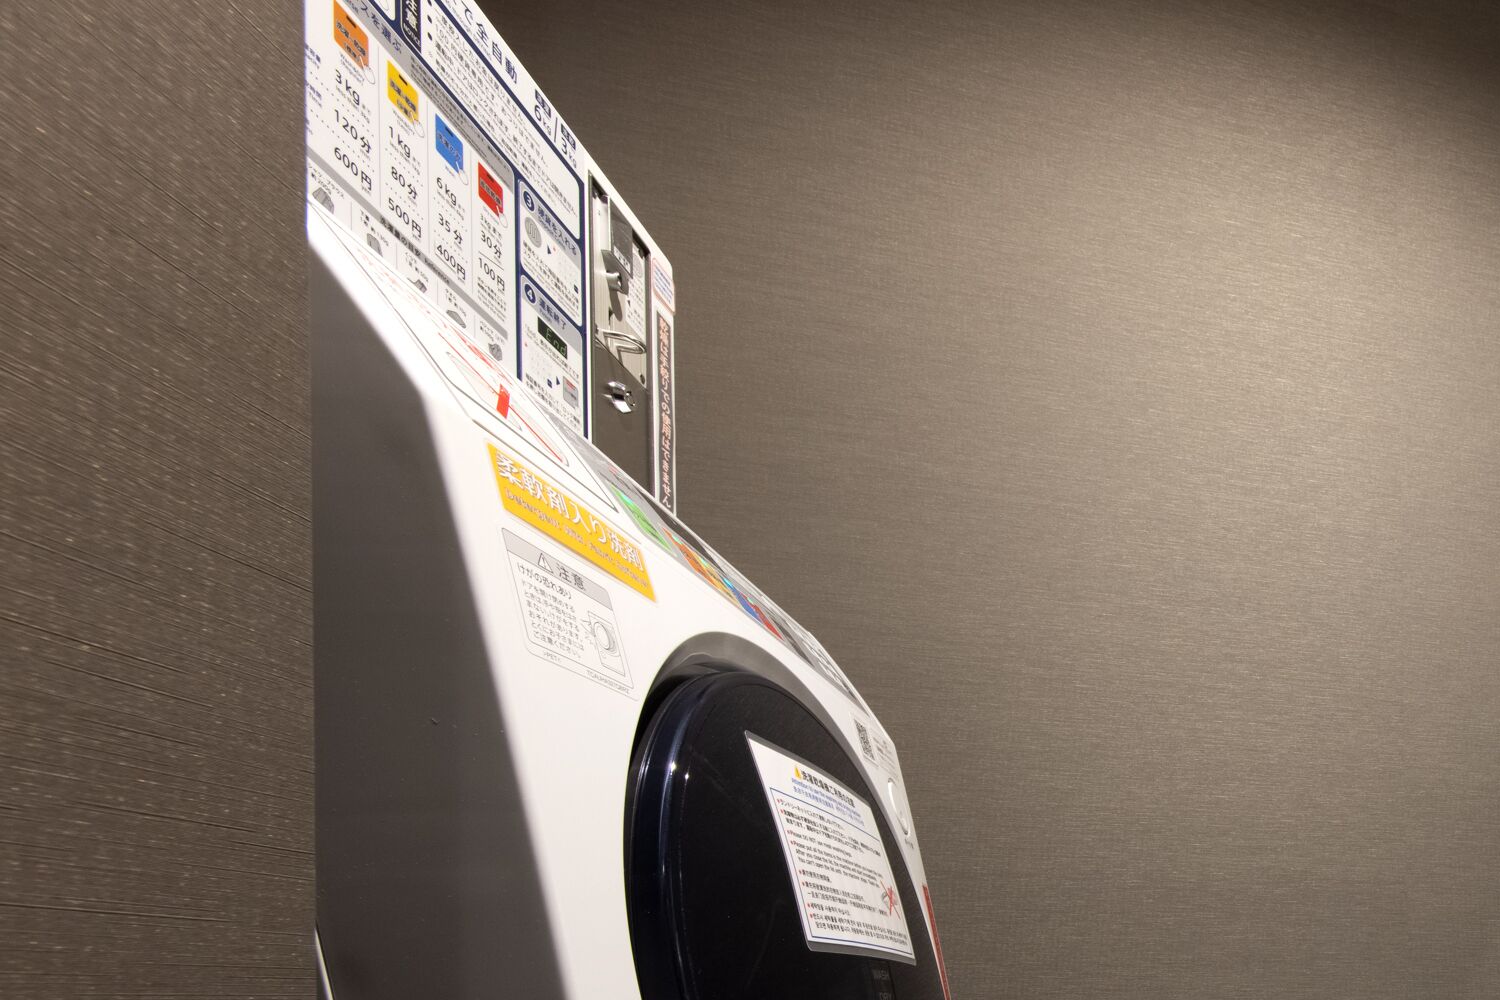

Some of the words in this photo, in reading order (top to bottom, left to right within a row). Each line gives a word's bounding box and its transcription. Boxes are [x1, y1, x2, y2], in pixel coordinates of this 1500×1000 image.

[403, 22, 420, 49] NOTICE
[461, 0, 517, 86] て全自動
[334, 106, 371, 156] 120分
[334, 144, 371, 192] 600円
[391, 164, 417, 202] 80分
[388, 195, 421, 240] 500円
[438, 211, 462, 246] 35分
[538, 204, 576, 257] 硬貨を入れる
[436, 242, 465, 281] 400円
[480, 229, 501, 261] 30分
[424, 257, 449, 287] Reference
[479, 256, 504, 293] 100円
[538, 295, 566, 332] 運転終了
[496, 452, 643, 571] 柔軟剤入り洗剤
[516, 561, 572, 601] けがの恐れあり
[556, 562, 585, 591] 注意
